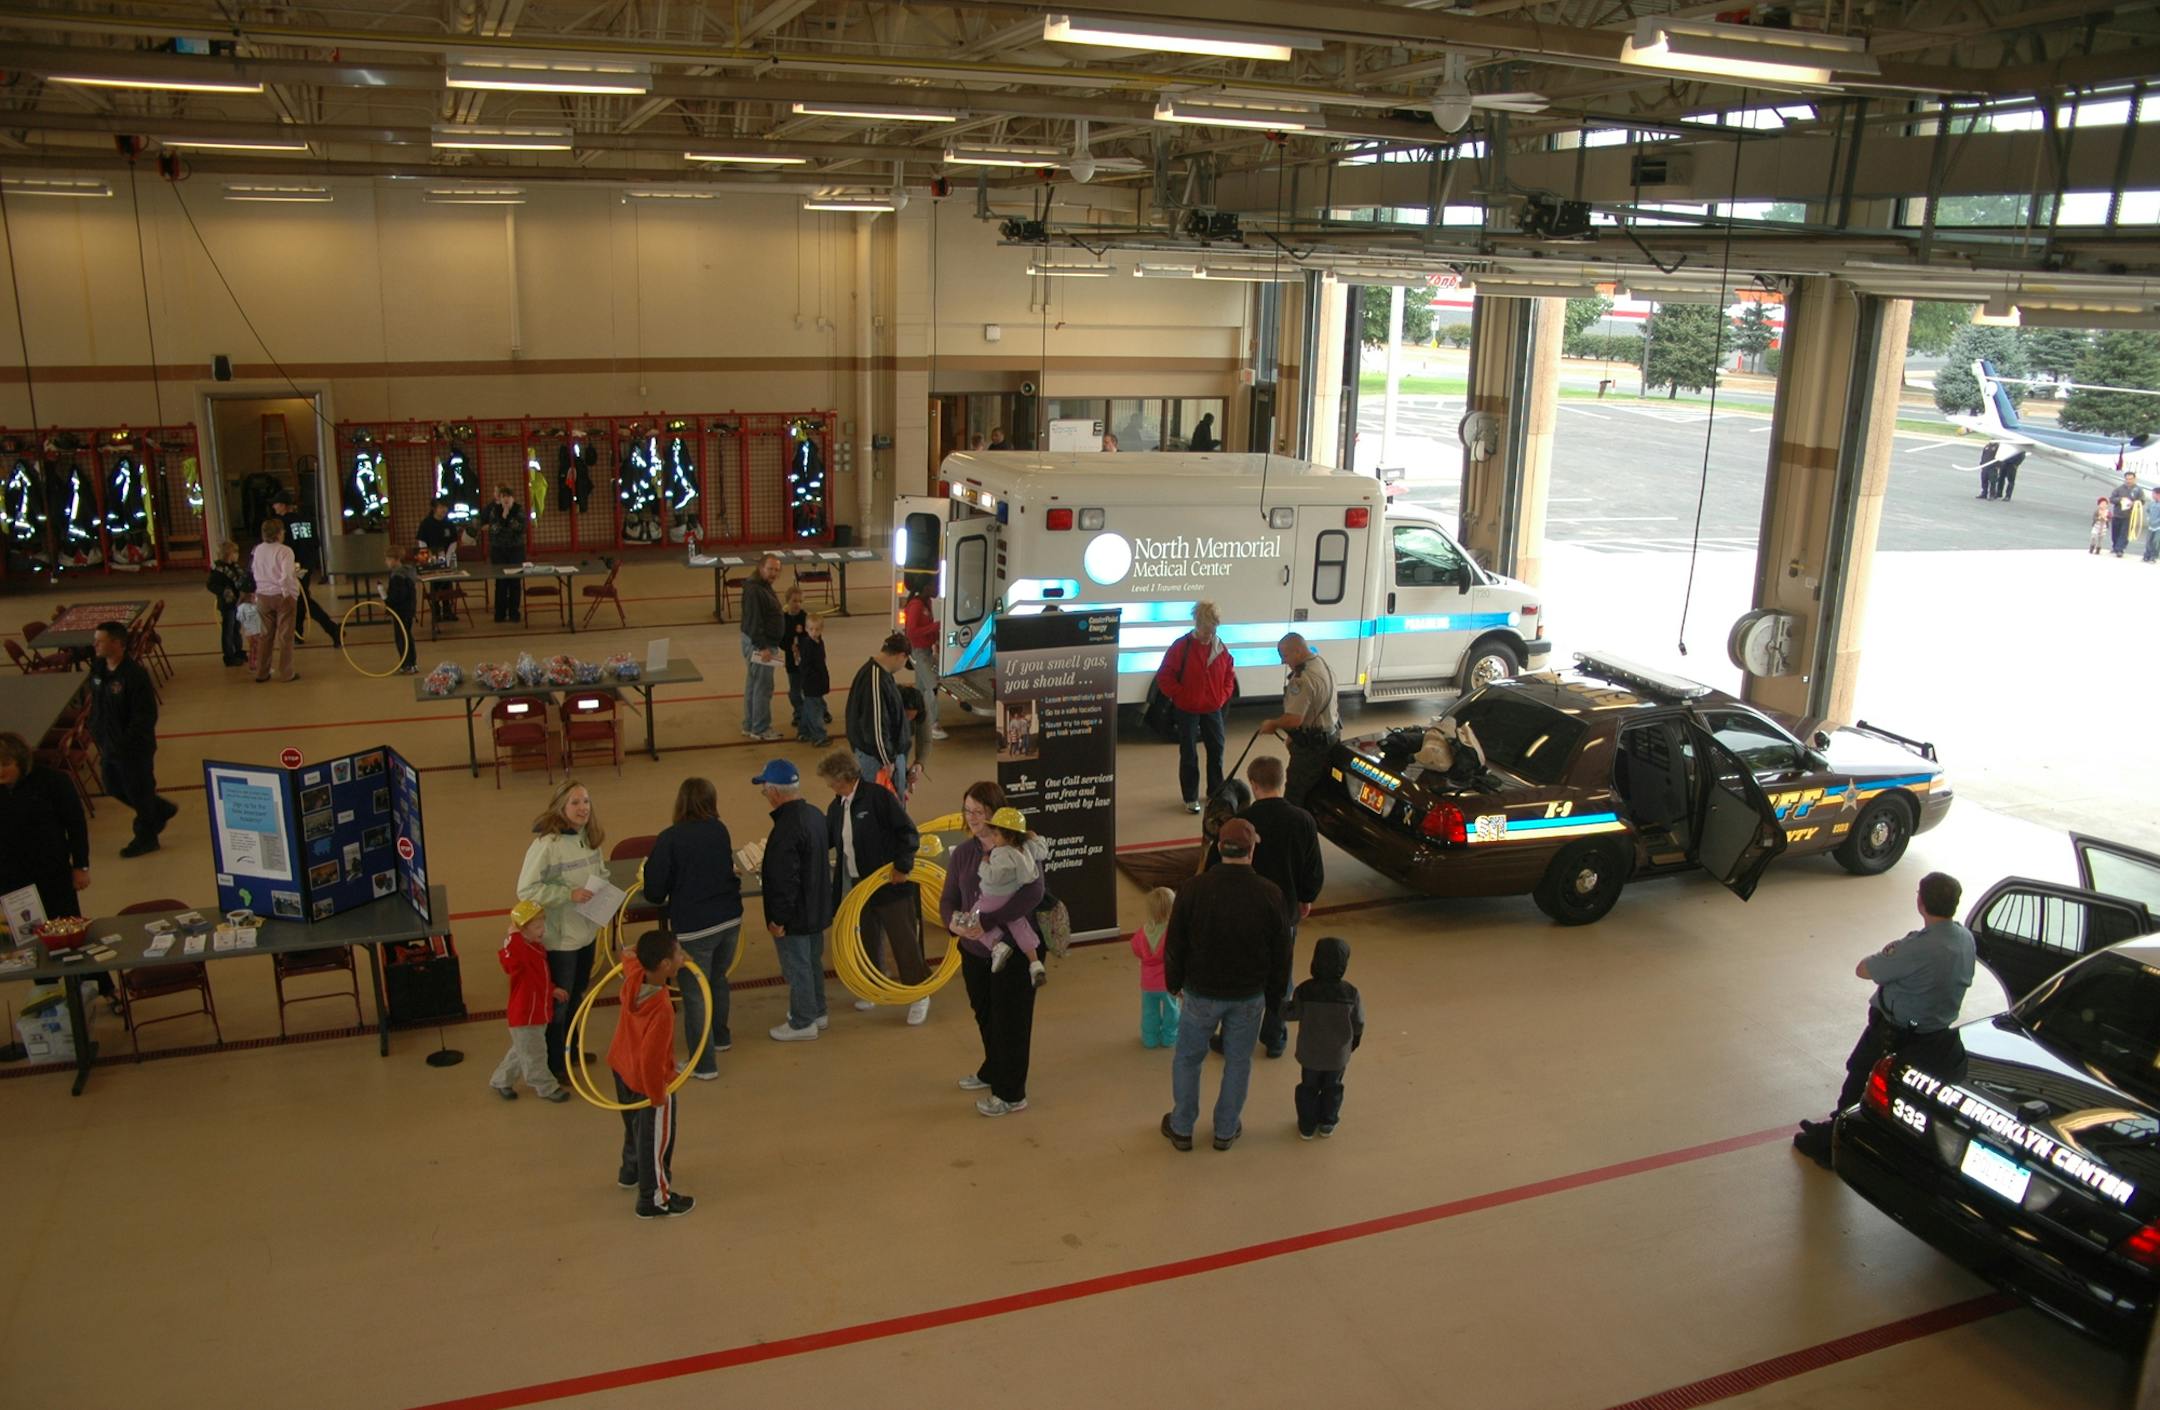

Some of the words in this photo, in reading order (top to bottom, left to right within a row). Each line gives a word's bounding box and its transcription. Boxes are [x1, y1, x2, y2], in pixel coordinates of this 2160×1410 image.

[1135, 536, 1190, 560] North
[1194, 535, 1281, 558] Memorial
[1133, 560, 1187, 578] Medical
[1191, 561, 1232, 576] Center
[1131, 584, 1149, 592] Level
[1157, 584, 1182, 592] Trauma
[1183, 582, 1205, 591] Center
[1088, 624, 1108, 633] Energy
[1005, 659, 1018, 676] If
[1020, 660, 1044, 674] you
[1048, 655, 1081, 670] smell
[1083, 656, 1108, 670] gas,
[1004, 679, 1030, 694] you
[1033, 672, 1076, 688] should
[1045, 696, 1061, 704] Leave
[1063, 693, 1095, 702] immediately
[1046, 731, 1056, 739] gas
[1057, 728, 1068, 736] leak
[1070, 726, 1092, 735] yourself
[1045, 778, 1061, 788] One
[1062, 775, 1080, 785] Call
[1081, 773, 1114, 784] services
[1350, 757, 1402, 791] SHERIFF
[1045, 791, 1059, 800] are
[1059, 788, 1077, 800] free
[1079, 786, 1096, 796] and
[1362, 787, 1370, 799] K
[1376, 795, 1383, 808] 9
[1045, 799, 1081, 813] required
[1082, 798, 1094, 809] by
[1094, 797, 1111, 806] law
[1545, 801, 1574, 818] K-9
[1057, 836, 1085, 845] aware
[1055, 845, 1087, 857] natural
[1088, 845, 1103, 856] gas
[1045, 859, 1083, 872] pipelines
[1892, 1098, 1927, 1133] 332
[1902, 1068, 1941, 1095] CITY
[1937, 1086, 1963, 1106] OF
[1959, 1097, 2054, 1158] BROOKLYN
[2052, 1147, 2135, 1205] CENTER
